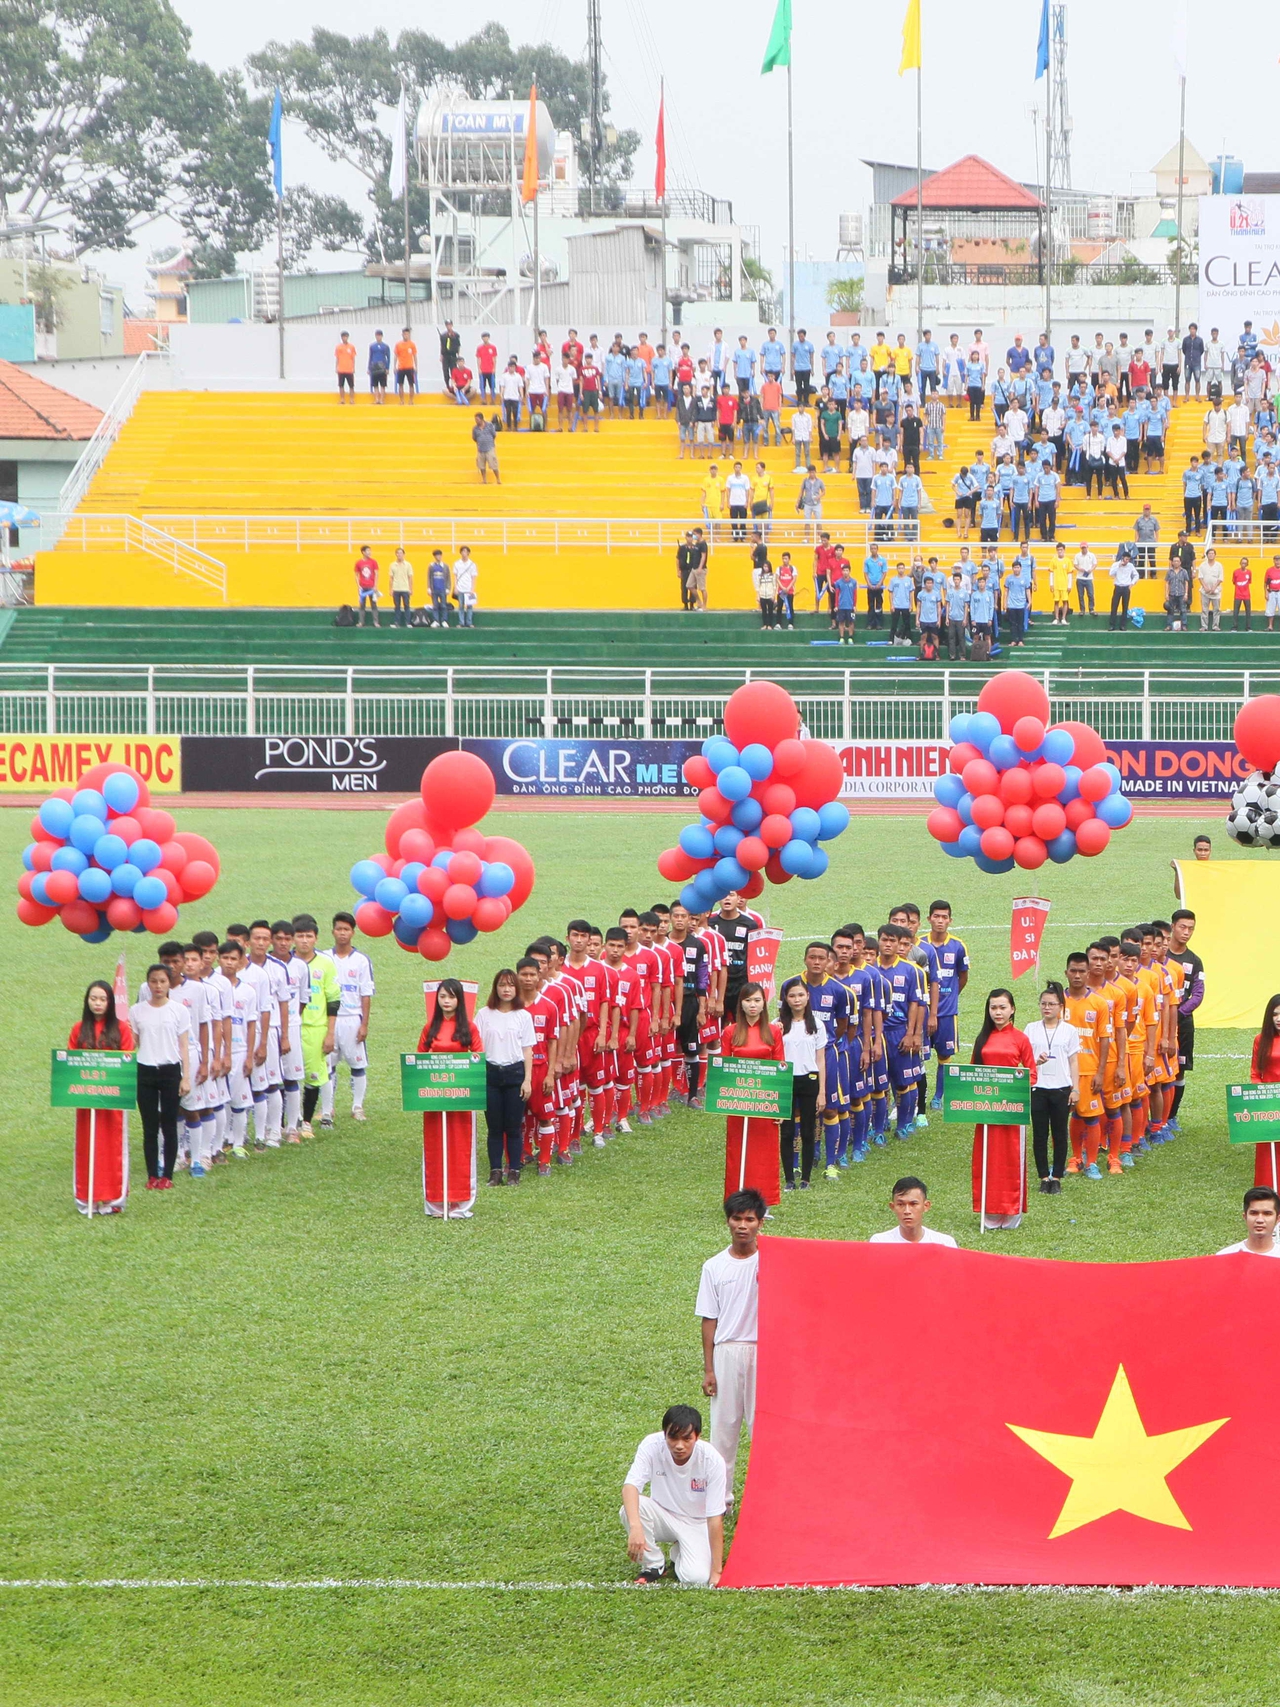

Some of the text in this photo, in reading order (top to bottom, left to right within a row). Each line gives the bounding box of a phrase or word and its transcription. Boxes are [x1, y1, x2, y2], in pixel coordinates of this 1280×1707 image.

[1256, 289, 1272, 297] CAO
[264, 737, 378, 767] POND'S
[124, 742, 174, 784] IDC
[502, 740, 685, 784] CLEAR ME
[834, 745, 892, 777] ANH
[1105, 749, 1256, 778] ON DONG
[332, 773, 377, 791] MEN
[841, 781, 934, 793] DIA CORPORAT
[1121, 780, 1242, 793] MADE IN VIETNA
[513, 784, 536, 794] ĐÀN
[543, 784, 568, 794] ÔNG
[574, 783, 601, 794] ĐỈNH
[608, 785, 632, 795] CAO
[638, 785, 677, 795] PHONG
[1013, 948, 1029, 961] ĐÀ
[430, 1072, 456, 1083] U.21
[736, 1077, 762, 1087] U.21
[973, 1085, 999, 1096] U.21
[950, 1100, 974, 1111] SHB
